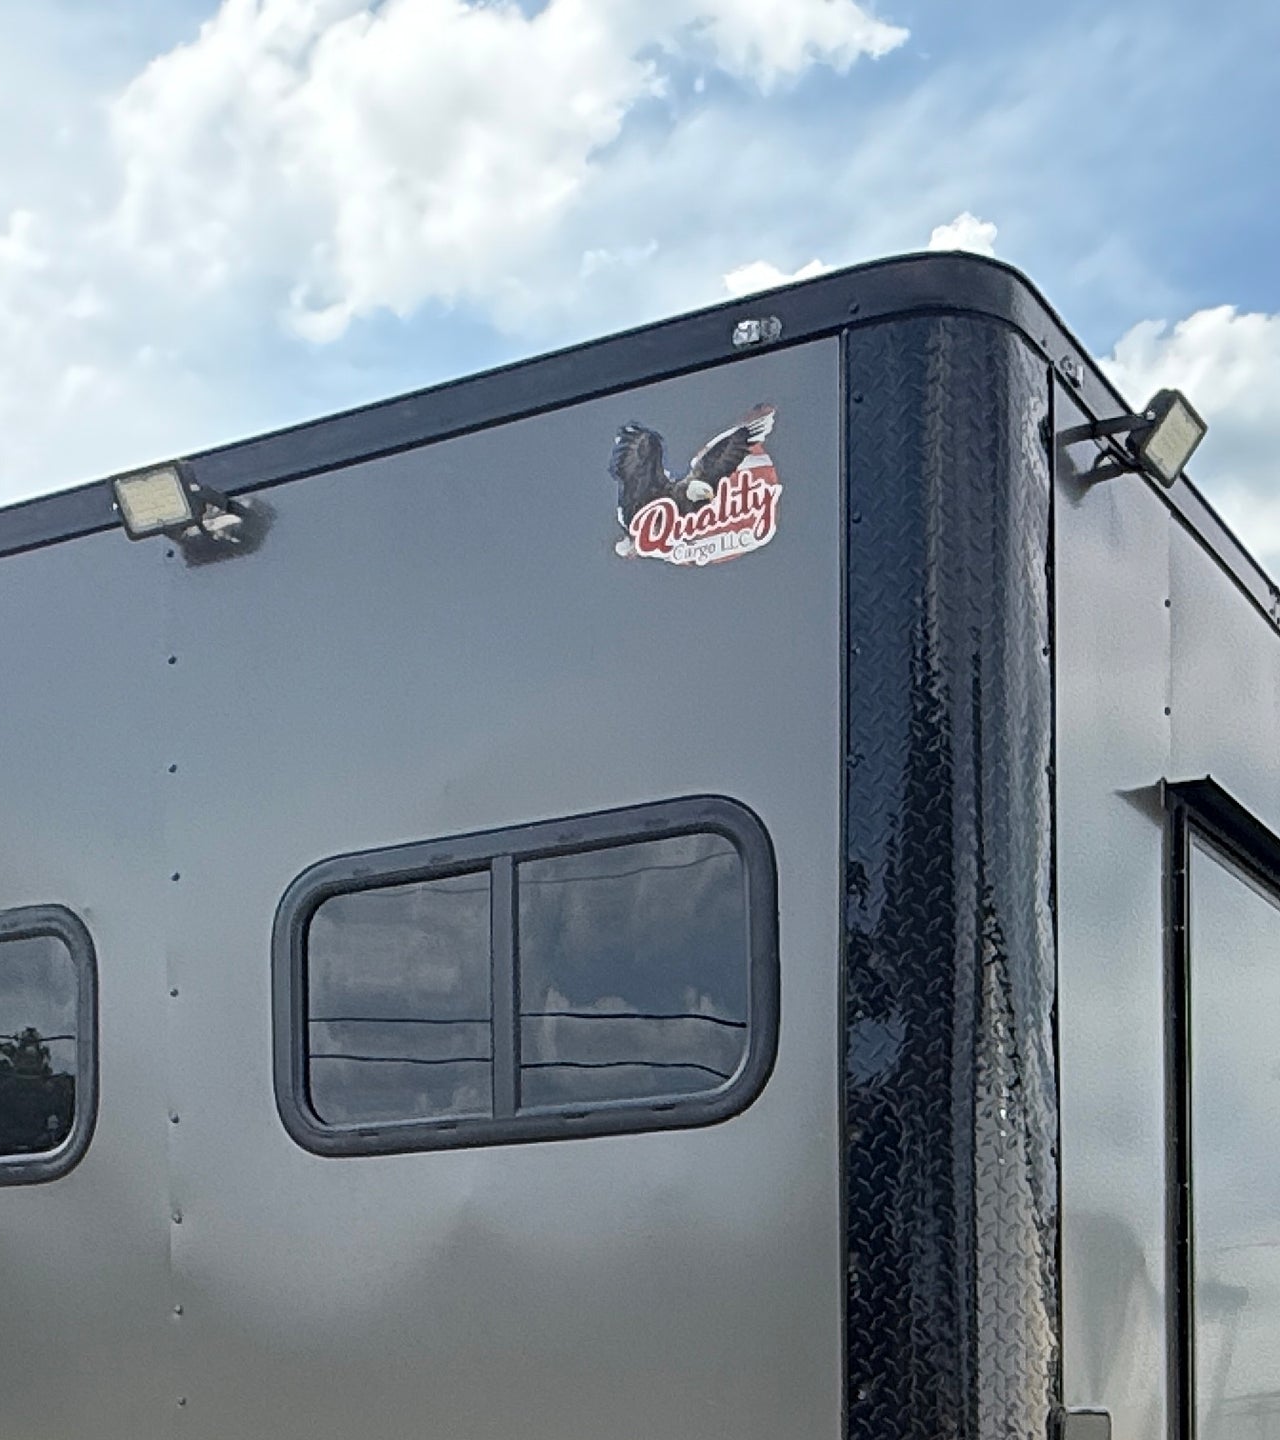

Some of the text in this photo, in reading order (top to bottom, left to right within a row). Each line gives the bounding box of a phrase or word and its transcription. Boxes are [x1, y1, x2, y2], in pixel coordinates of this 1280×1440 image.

[632, 473, 778, 553] Quality
[672, 530, 752, 562] Cargo LLC
